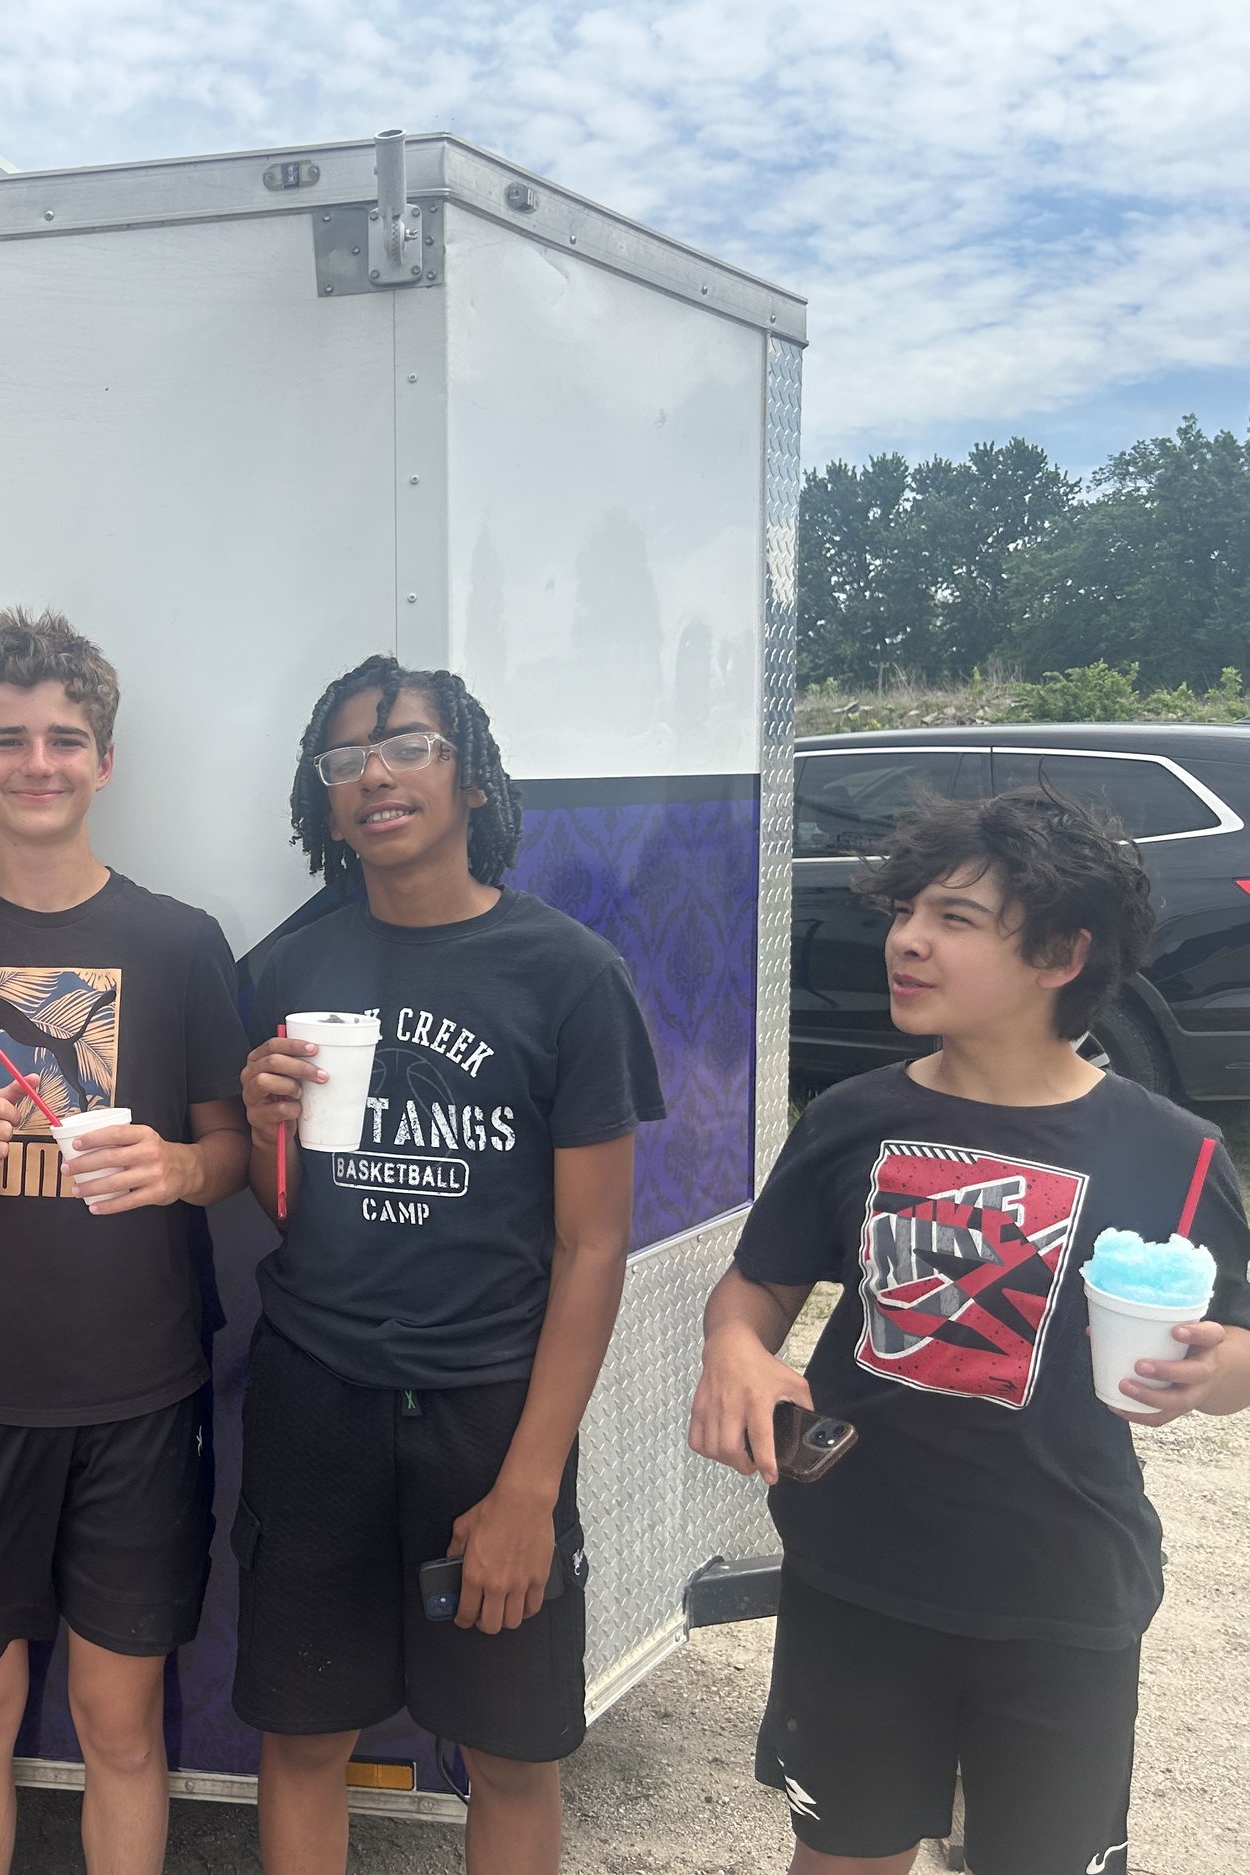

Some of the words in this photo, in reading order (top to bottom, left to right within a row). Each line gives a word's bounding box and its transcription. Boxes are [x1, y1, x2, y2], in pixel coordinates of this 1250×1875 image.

[396, 1006, 495, 1079] CREEK
[366, 1096, 516, 1151] TANGS
[336, 1156, 460, 1189] BASKETBALL
[362, 1198, 430, 1226] CAMP
